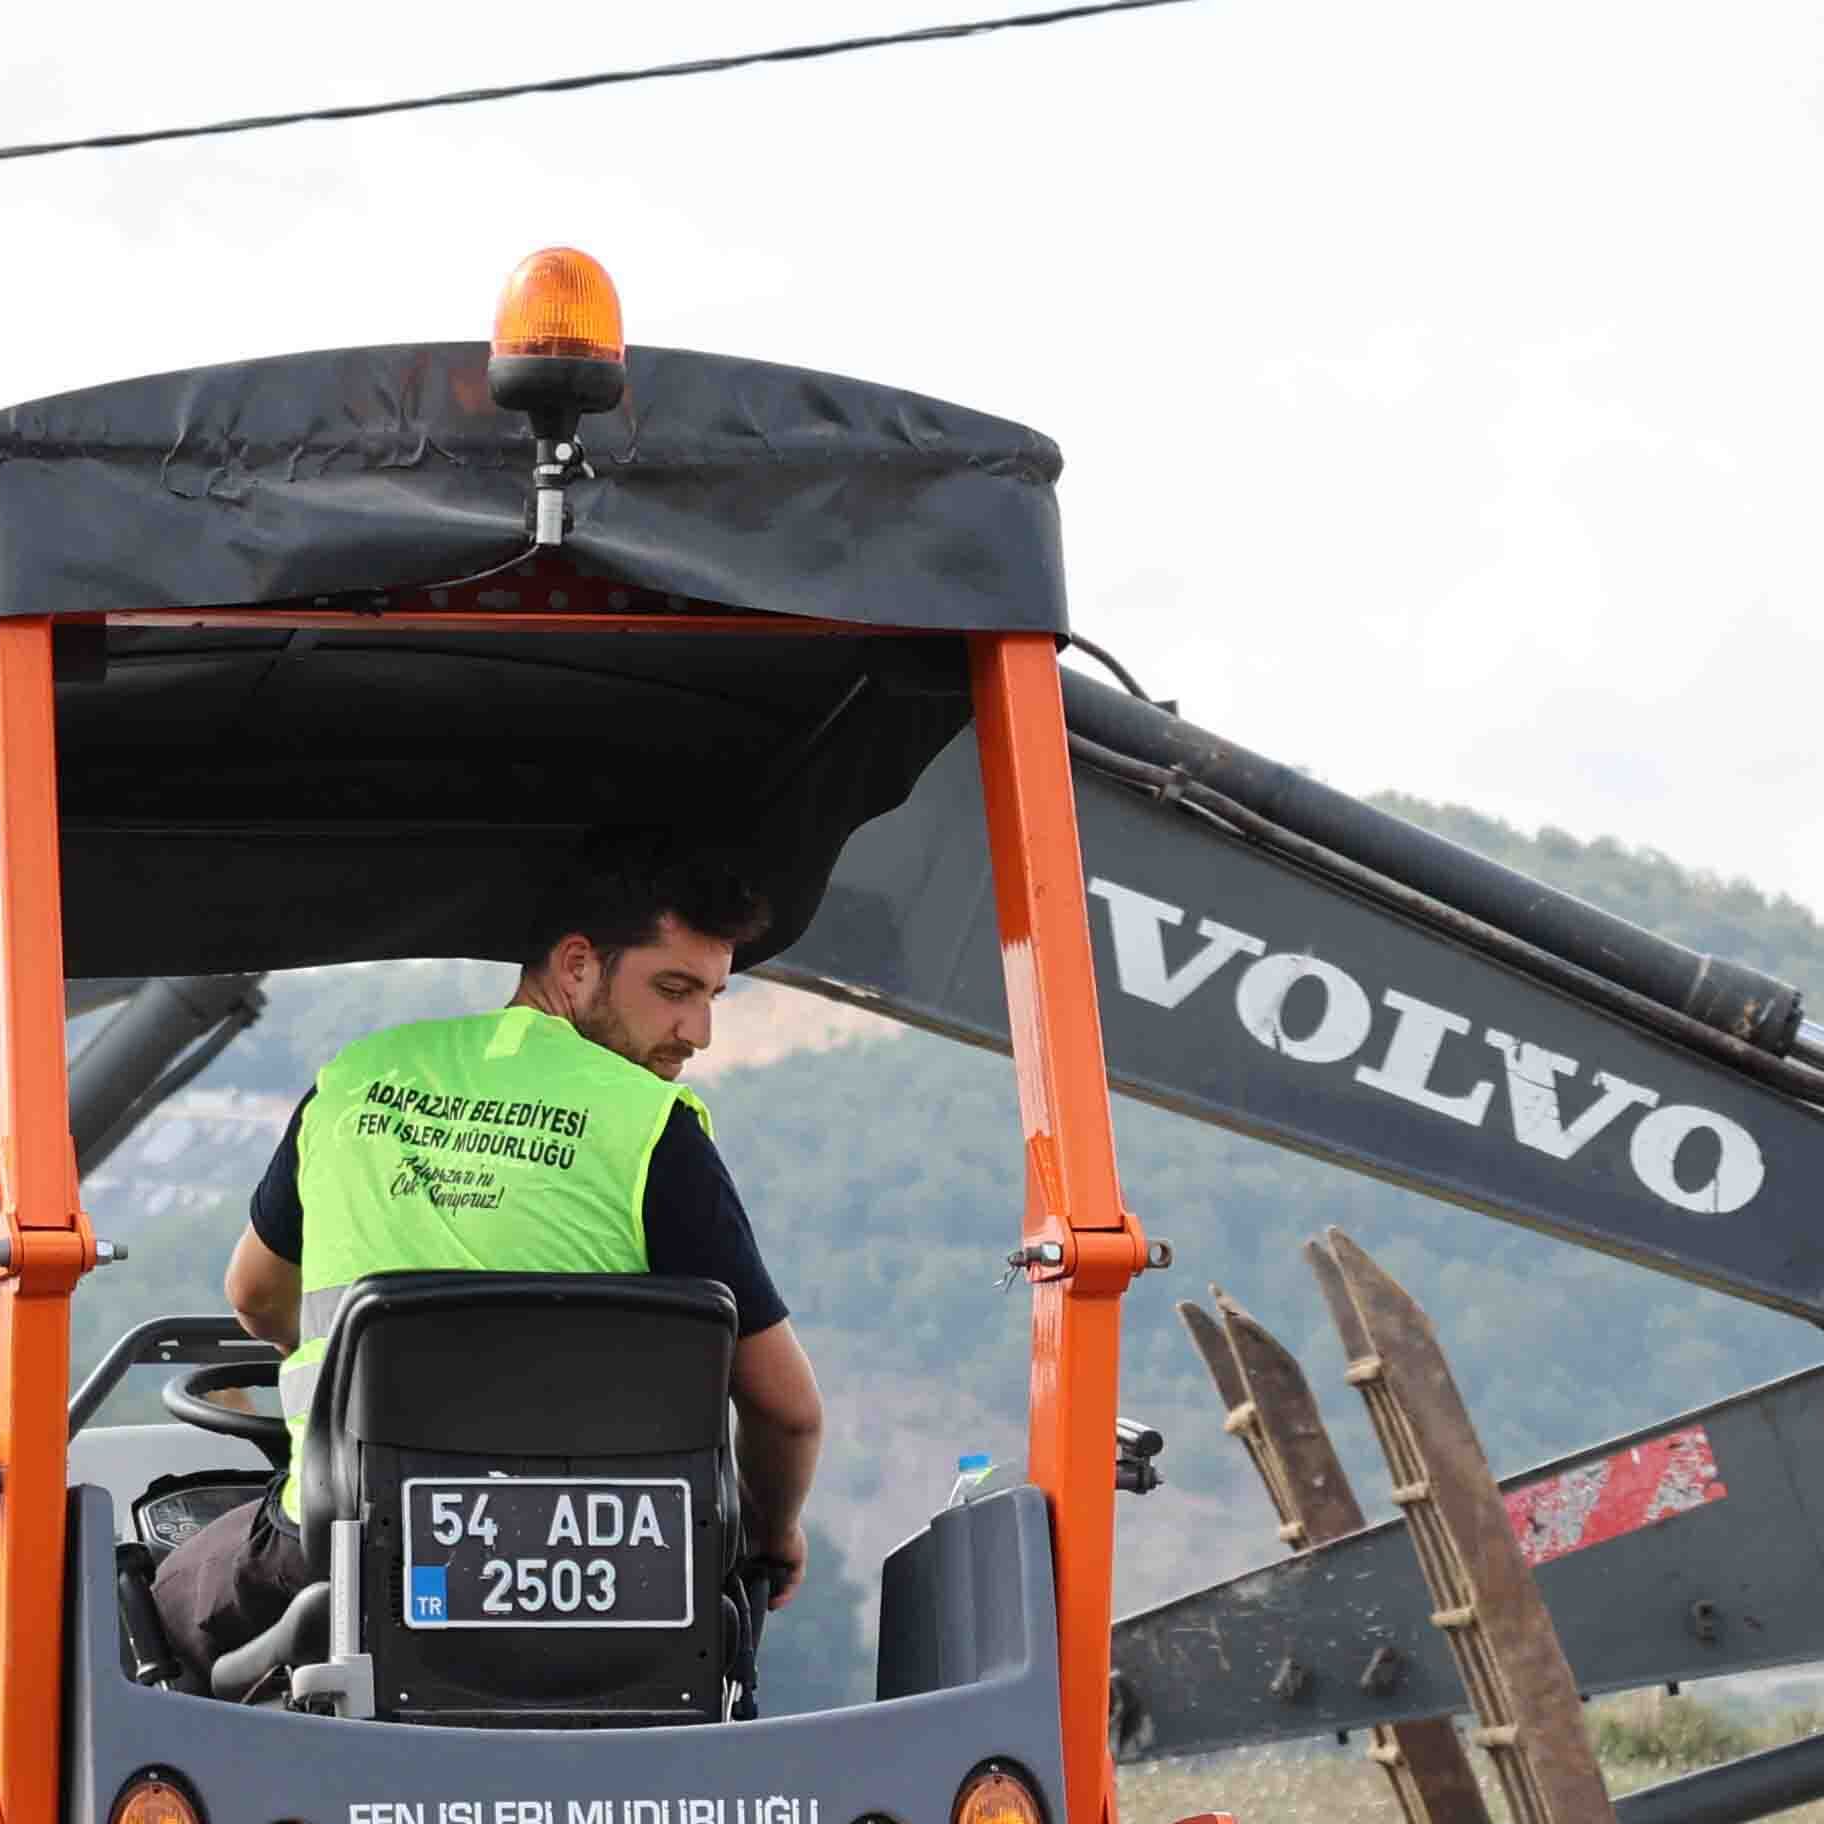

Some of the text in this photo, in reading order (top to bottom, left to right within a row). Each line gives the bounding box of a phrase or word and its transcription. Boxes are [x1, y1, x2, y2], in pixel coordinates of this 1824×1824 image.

[1088, 876, 1765, 1215] VOLVO
[366, 1081, 588, 1139] ADAPAZARI BELEDİYESİ
[357, 1113, 392, 1137] FEN
[452, 1128, 576, 1170] MÜDÜRLÜĞÜ
[432, 1493, 665, 1547] 54 ADA
[416, 1597, 443, 1616] TR
[482, 1559, 617, 1613] 2503
